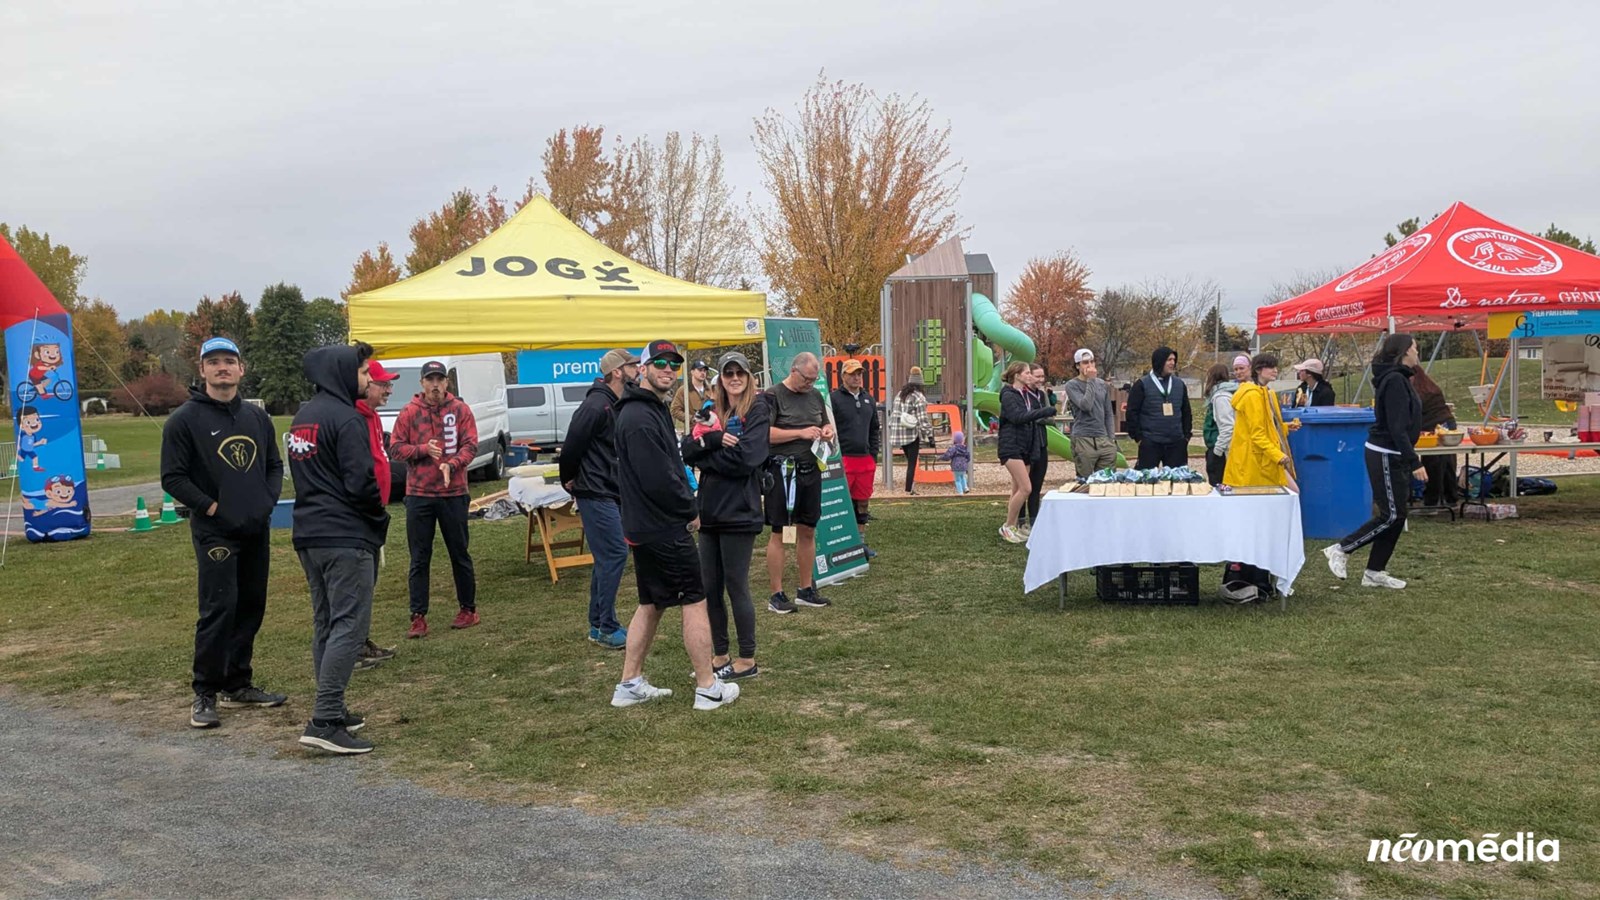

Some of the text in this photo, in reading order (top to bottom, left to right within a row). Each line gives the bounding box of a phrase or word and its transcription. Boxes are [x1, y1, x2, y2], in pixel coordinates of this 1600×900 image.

[1459, 231, 1518, 243] FONDATION
[1440, 287, 1470, 309] De
[1477, 289, 1549, 307] nature
[1314, 301, 1365, 321] GÉNÉREUSE
[552, 358, 603, 379] premi
